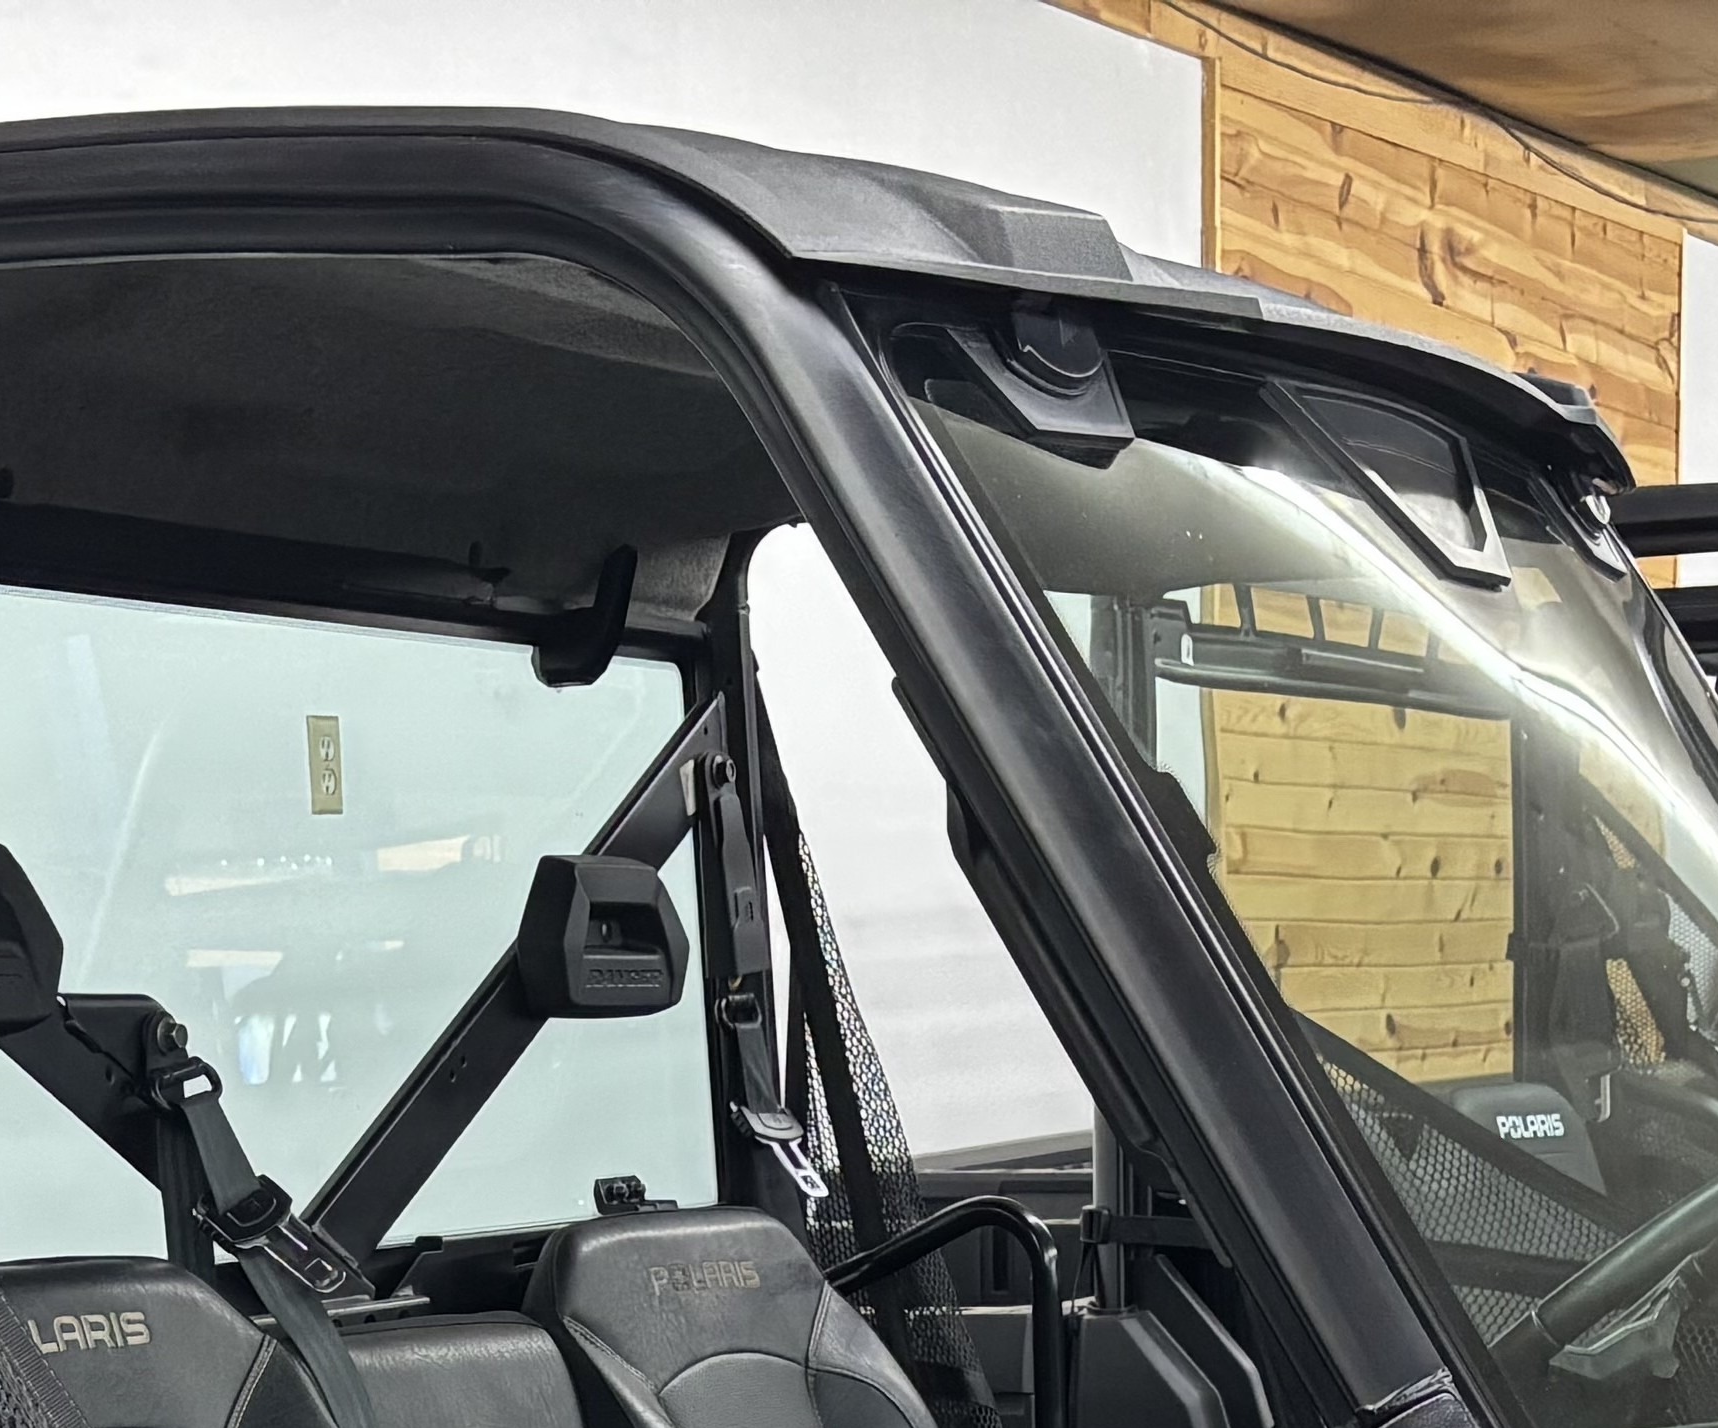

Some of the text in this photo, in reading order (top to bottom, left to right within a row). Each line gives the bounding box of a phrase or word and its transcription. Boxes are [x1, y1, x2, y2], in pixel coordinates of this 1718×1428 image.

[1495, 1113, 1565, 1139] POLARIS
[649, 1259, 761, 1297] POLARIS
[27, 1311, 151, 1354] LARIS
